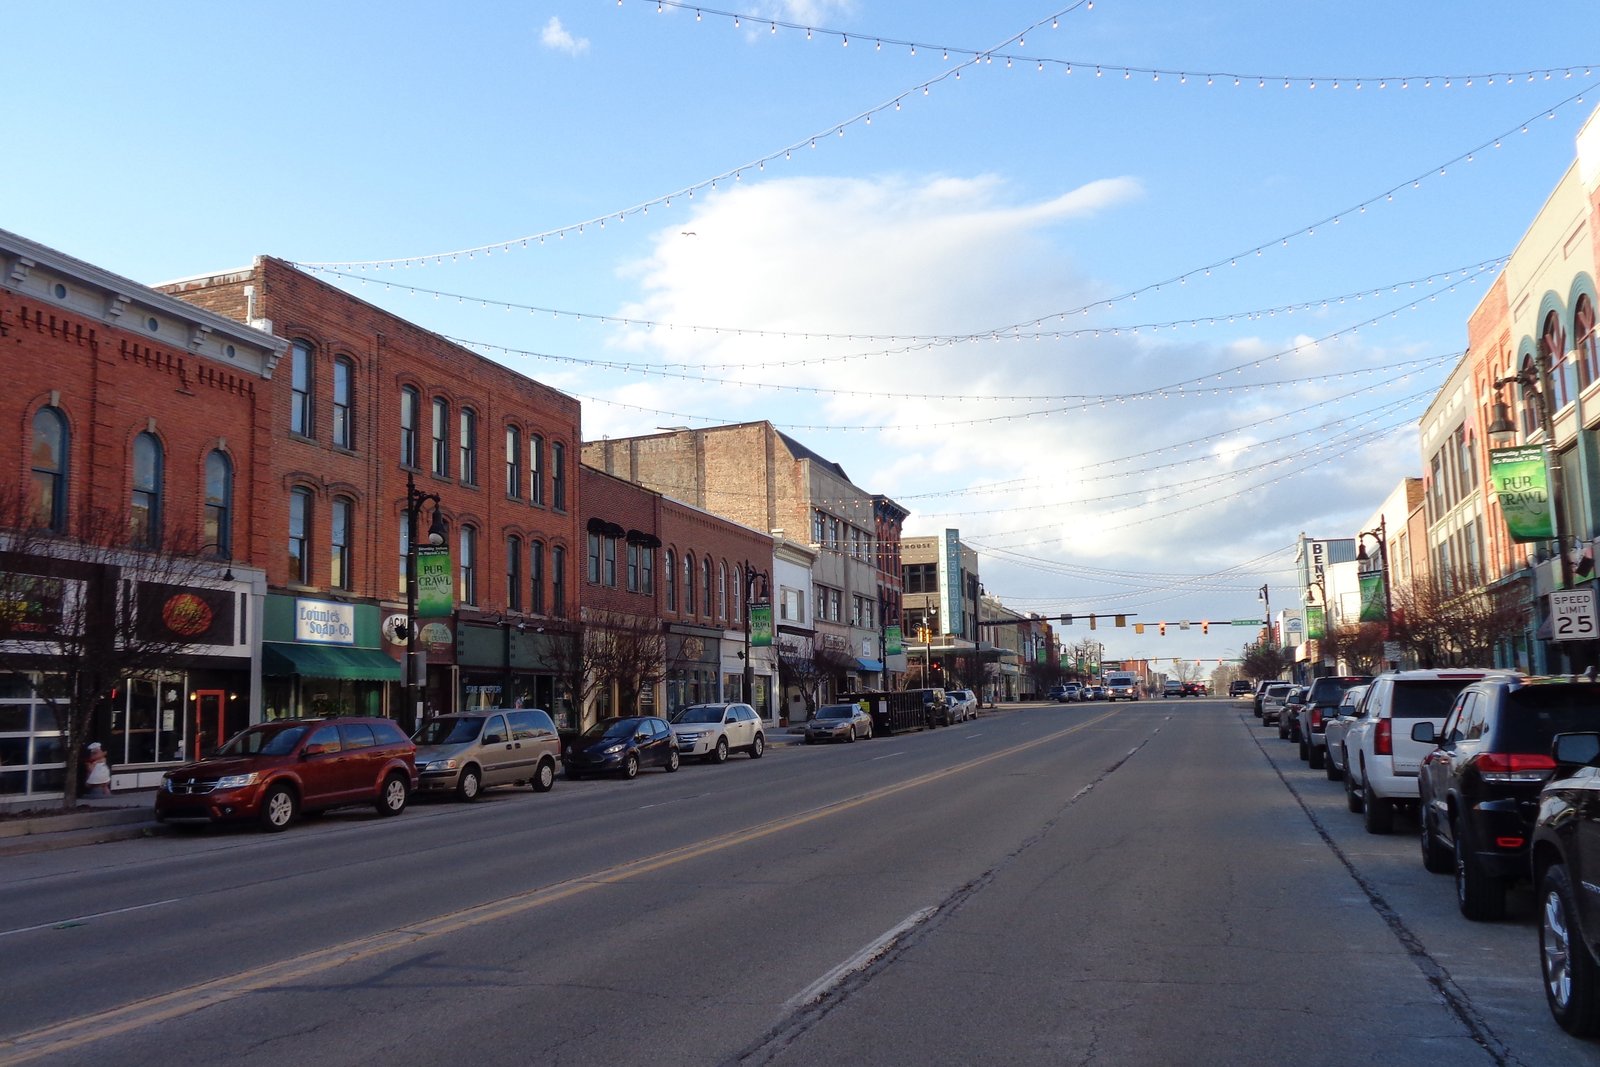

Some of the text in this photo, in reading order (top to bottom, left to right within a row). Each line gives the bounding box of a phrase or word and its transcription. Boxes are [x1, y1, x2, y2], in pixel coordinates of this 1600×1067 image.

[1498, 491, 1547, 506] CRAWL
[418, 576, 452, 587] CRAWL
[1553, 595, 1591, 605] SPEED
[1558, 605, 1588, 615] LIMIT
[388, 616, 408, 627] ACM
[1557, 615, 1593, 634] 25
[309, 620, 336, 637] Soap
